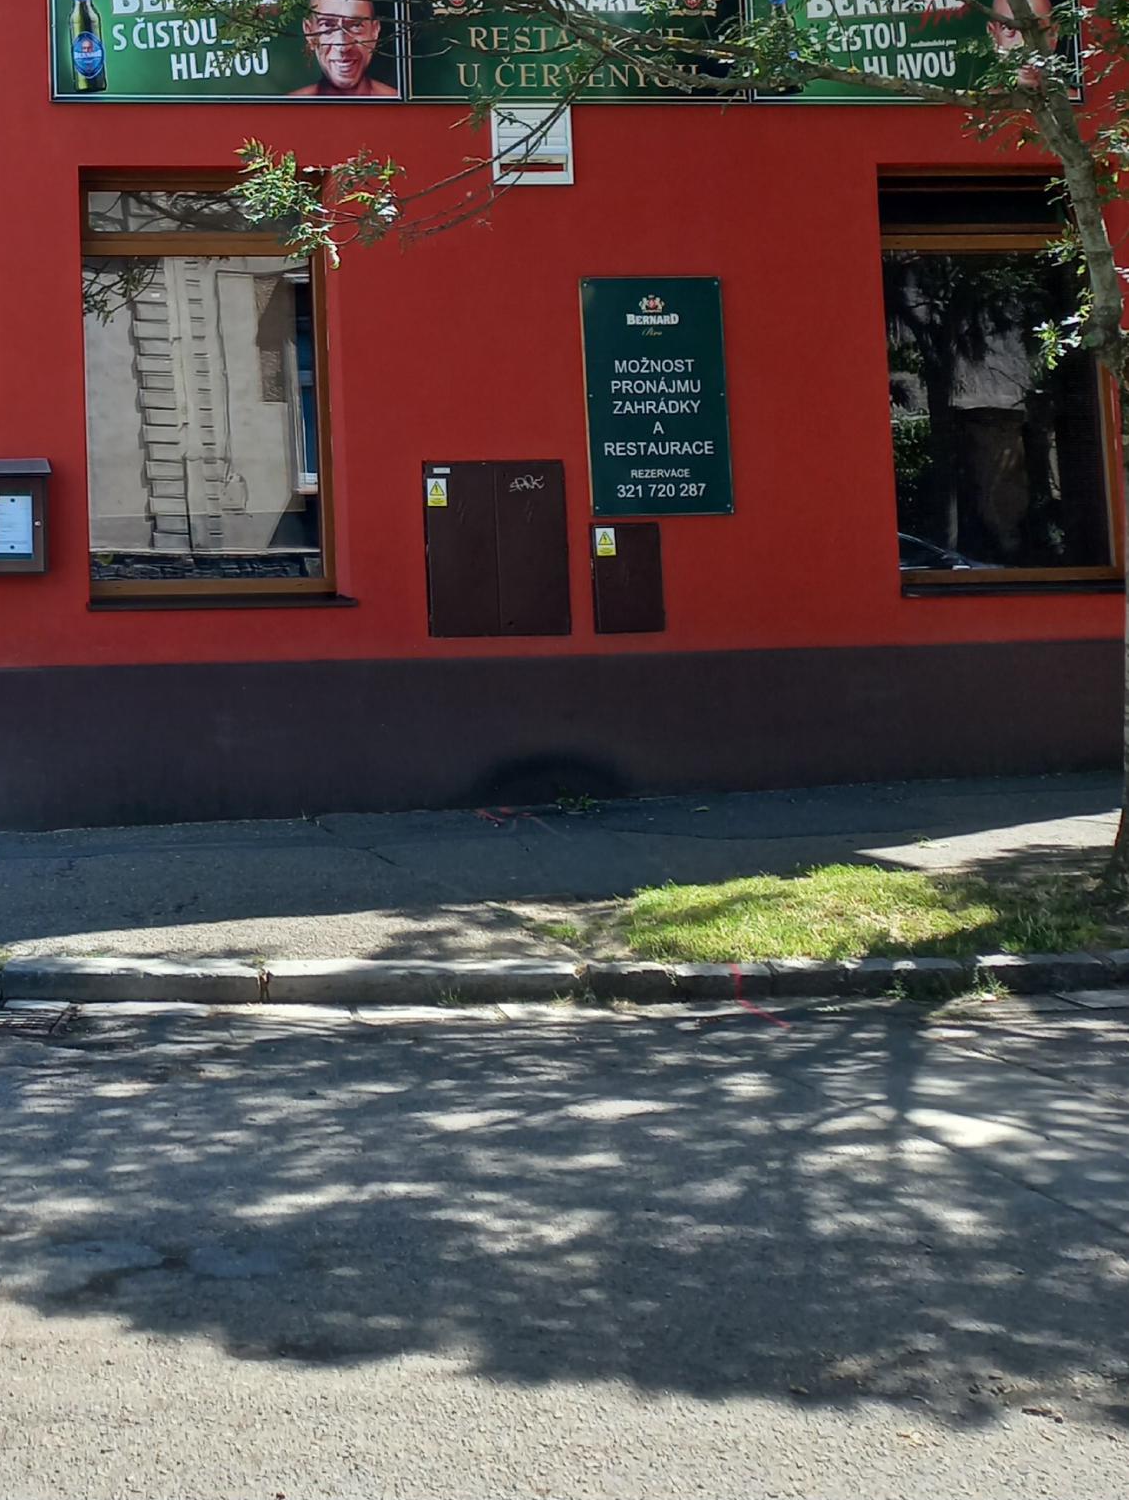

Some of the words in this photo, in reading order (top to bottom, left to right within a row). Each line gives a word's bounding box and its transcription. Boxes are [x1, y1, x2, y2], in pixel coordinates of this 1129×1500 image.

[112, 23, 128, 51] S
[133, 17, 218, 50] ČISTOU
[826, 20, 907, 53] ČISTOU
[170, 47, 270, 81] HLAVOU
[456, 63, 479, 88] U
[626, 313, 679, 325] BERNARD
[614, 357, 694, 374] MOŽNOST
[611, 377, 701, 394] PRONÁJMU
[613, 397, 701, 414] ZAHRÁDKY
[653, 421, 665, 435] A
[604, 441, 714, 456] RESTAURACE
[631, 468, 690, 479] REZERVACE
[617, 485, 643, 498] 321
[648, 484, 676, 498] 720
[679, 483, 706, 496] 287
